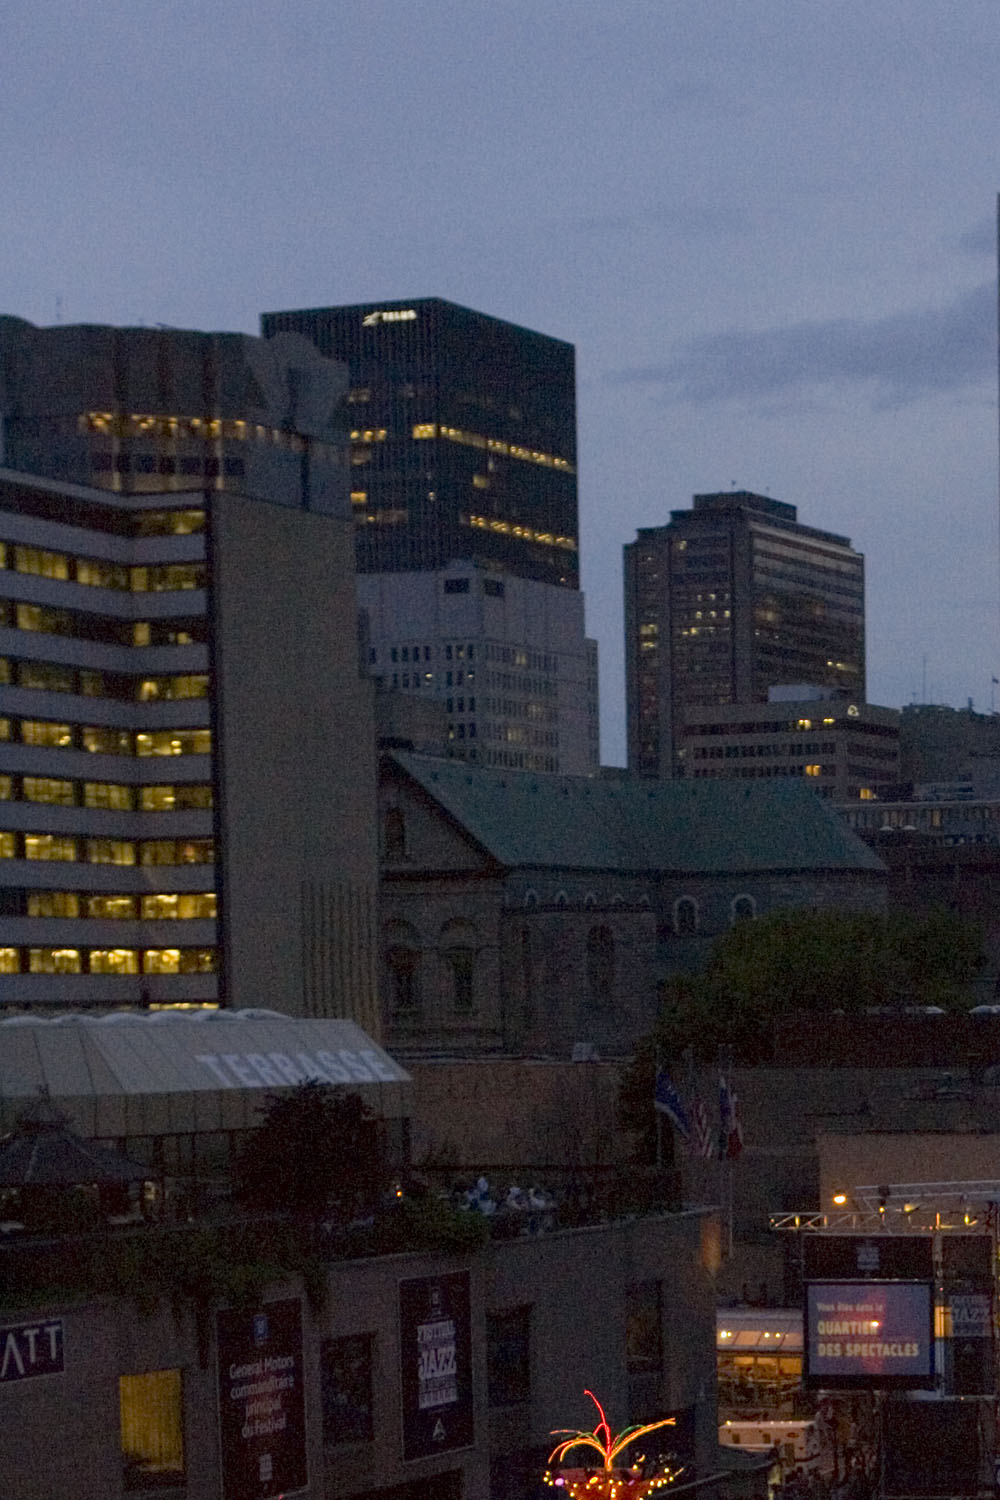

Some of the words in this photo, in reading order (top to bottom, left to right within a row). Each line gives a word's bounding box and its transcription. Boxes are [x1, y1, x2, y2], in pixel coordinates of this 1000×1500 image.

[818, 1321, 878, 1335] QUARTIER
[819, 1343, 841, 1357] DES
[845, 1343, 919, 1357] SPECTACLES
[418, 1347, 457, 1380] JAZZ
